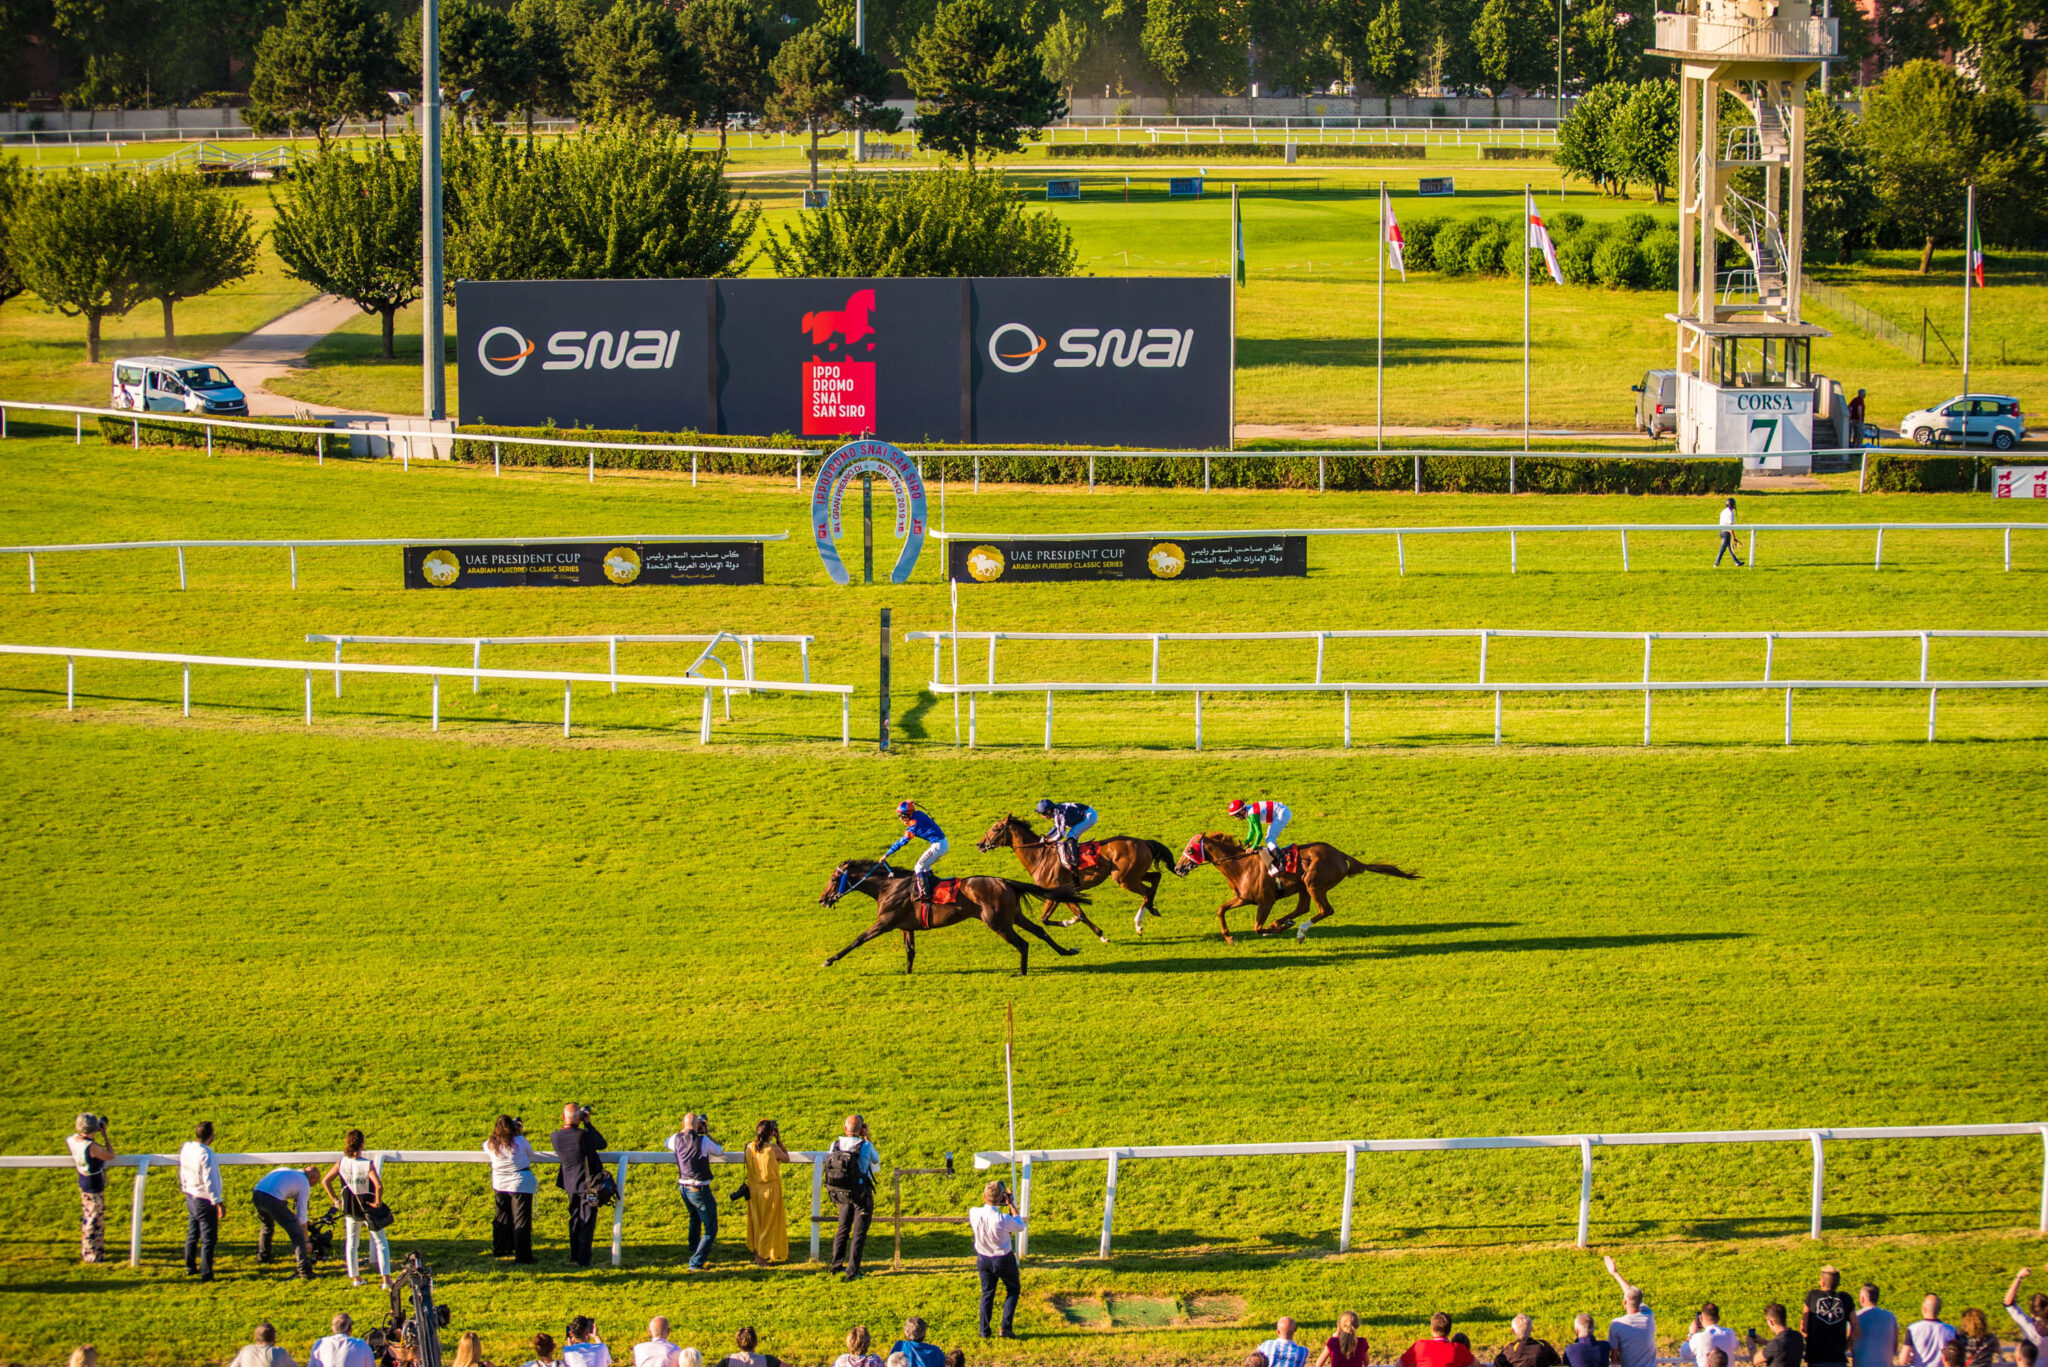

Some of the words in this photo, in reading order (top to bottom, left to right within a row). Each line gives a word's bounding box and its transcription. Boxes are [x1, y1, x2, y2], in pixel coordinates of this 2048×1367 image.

[813, 366, 840, 378] IPPO
[813, 379, 854, 391] DROMO
[813, 392, 841, 404] SNAI
[1737, 394, 1793, 410] CORSA
[813, 405, 836, 417] SAN
[839, 405, 865, 417] SIRO
[1750, 419, 1778, 464] 7
[854, 464, 863, 473] DI
[815, 447, 857, 505] IPPODROMO
[860, 444, 888, 457] SNAI
[889, 452, 911, 472] SAN
[905, 473, 922, 500] SIRO
[836, 469, 854, 497] PREMIO
[877, 464, 903, 495] MILANO
[833, 497, 841, 520] GRAN
[1191, 547, 1209, 556] رئيس
[1210, 546, 1233, 555] السمو
[1234, 545, 1263, 554] صاحب
[465, 554, 488, 565] UAE
[492, 553, 553, 564] PRESIDENT
[556, 552, 581, 563] CUP
[646, 552, 665, 561] رئيس
[666, 551, 688, 561] السمو
[690, 551, 719, 559] صاحب
[1010, 550, 1033, 561] UAE
[1036, 549, 1098, 560] PRESIDENT
[1101, 548, 1126, 559] CUP
[1103, 560, 1124, 568] SERIES
[1218, 556, 1241, 565] العربية
[1269, 555, 1283, 564] دولة
[558, 565, 579, 573] SERIES
[646, 562, 672, 570] المتحدة
[674, 562, 697, 571] العربية
[721, 561, 739, 570] دولة
